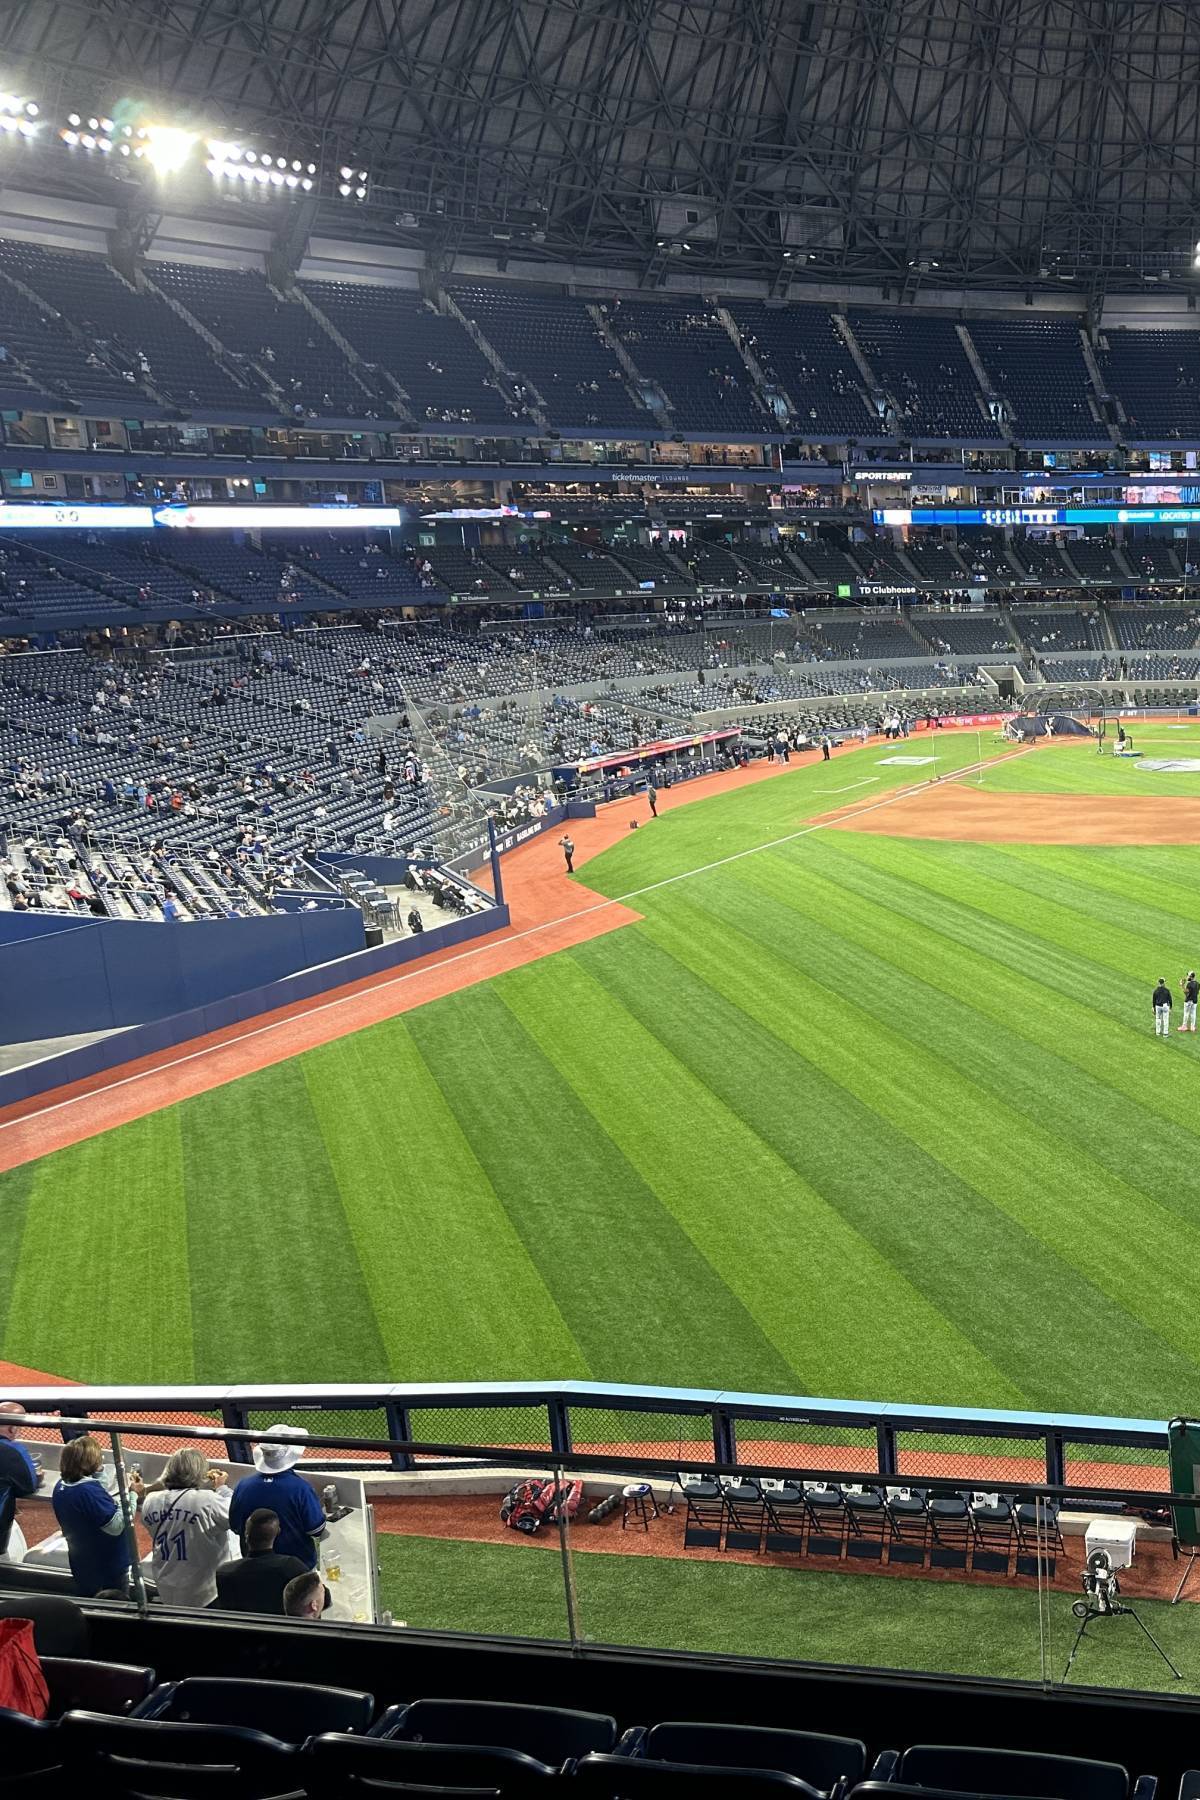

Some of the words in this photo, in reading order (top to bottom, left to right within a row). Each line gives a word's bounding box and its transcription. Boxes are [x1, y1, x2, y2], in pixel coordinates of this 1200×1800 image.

[612, 473, 659, 481] ticketmaster
[855, 472, 912, 480] SPORTSNET
[420, 536, 434, 545] TD
[873, 586, 916, 594] Clubhouse
[157, 1529, 187, 1561] 11
